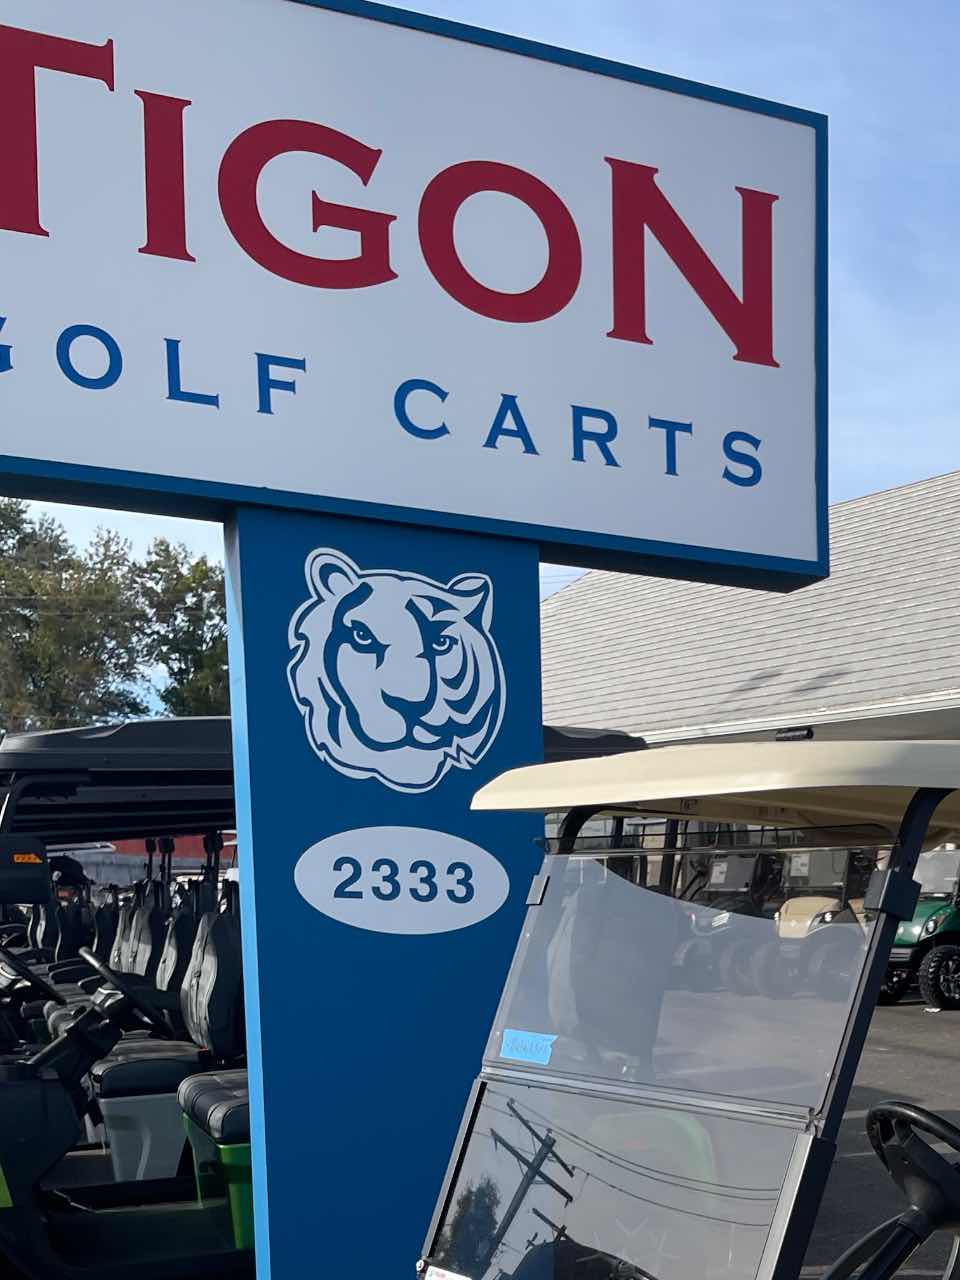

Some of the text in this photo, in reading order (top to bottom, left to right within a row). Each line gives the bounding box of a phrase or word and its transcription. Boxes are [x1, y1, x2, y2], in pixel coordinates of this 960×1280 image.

[0, 25, 779, 368] TIGON
[0, 316, 764, 488] OLF CARTS
[332, 856, 475, 904] 2333
